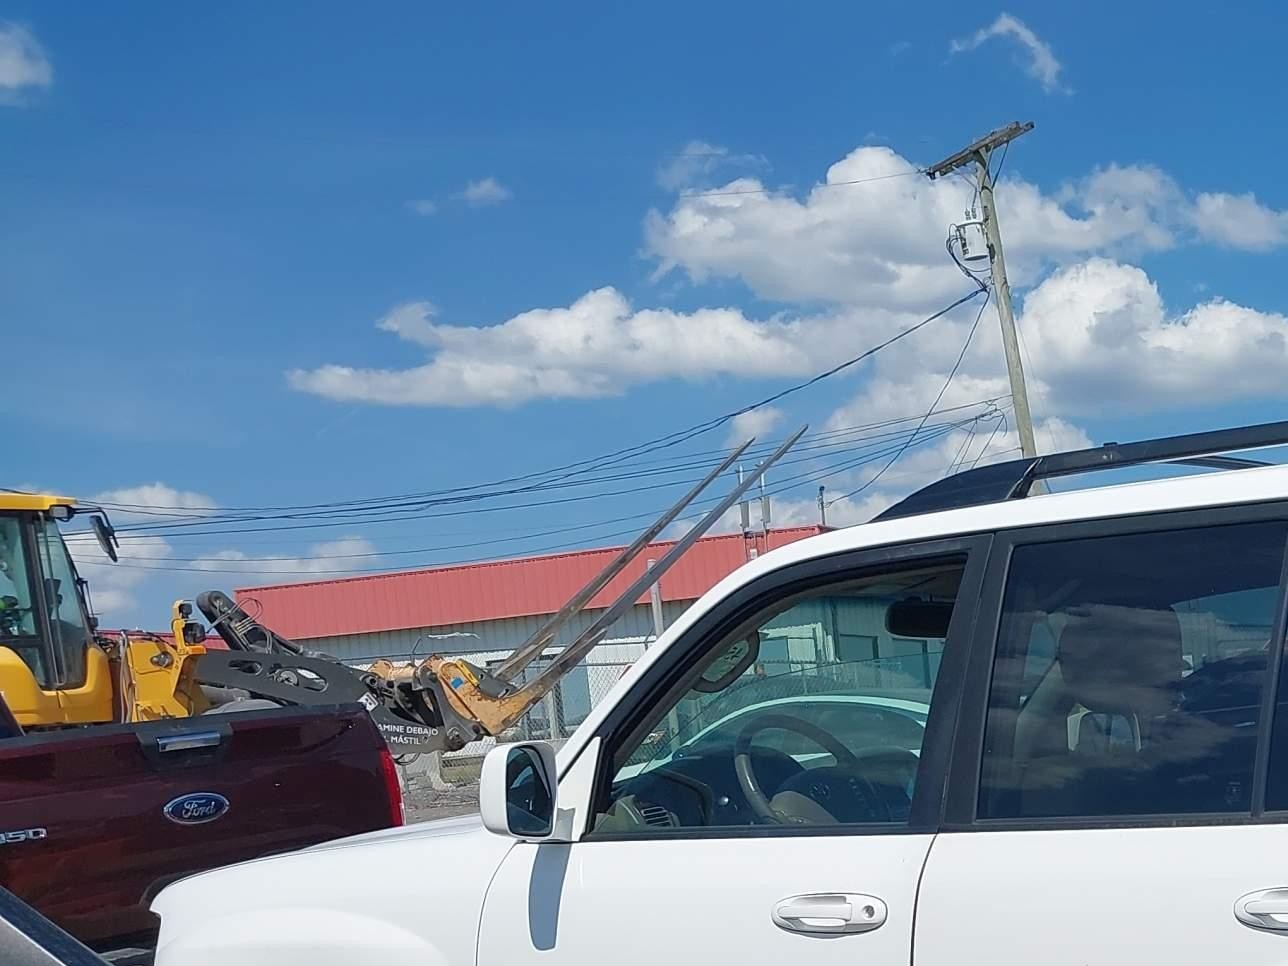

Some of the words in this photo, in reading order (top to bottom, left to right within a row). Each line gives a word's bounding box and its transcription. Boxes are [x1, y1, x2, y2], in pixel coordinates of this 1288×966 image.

[406, 726, 438, 737] DEBAJO
[391, 734, 421, 745] MÁSTIL
[182, 800, 216, 818] Ford
